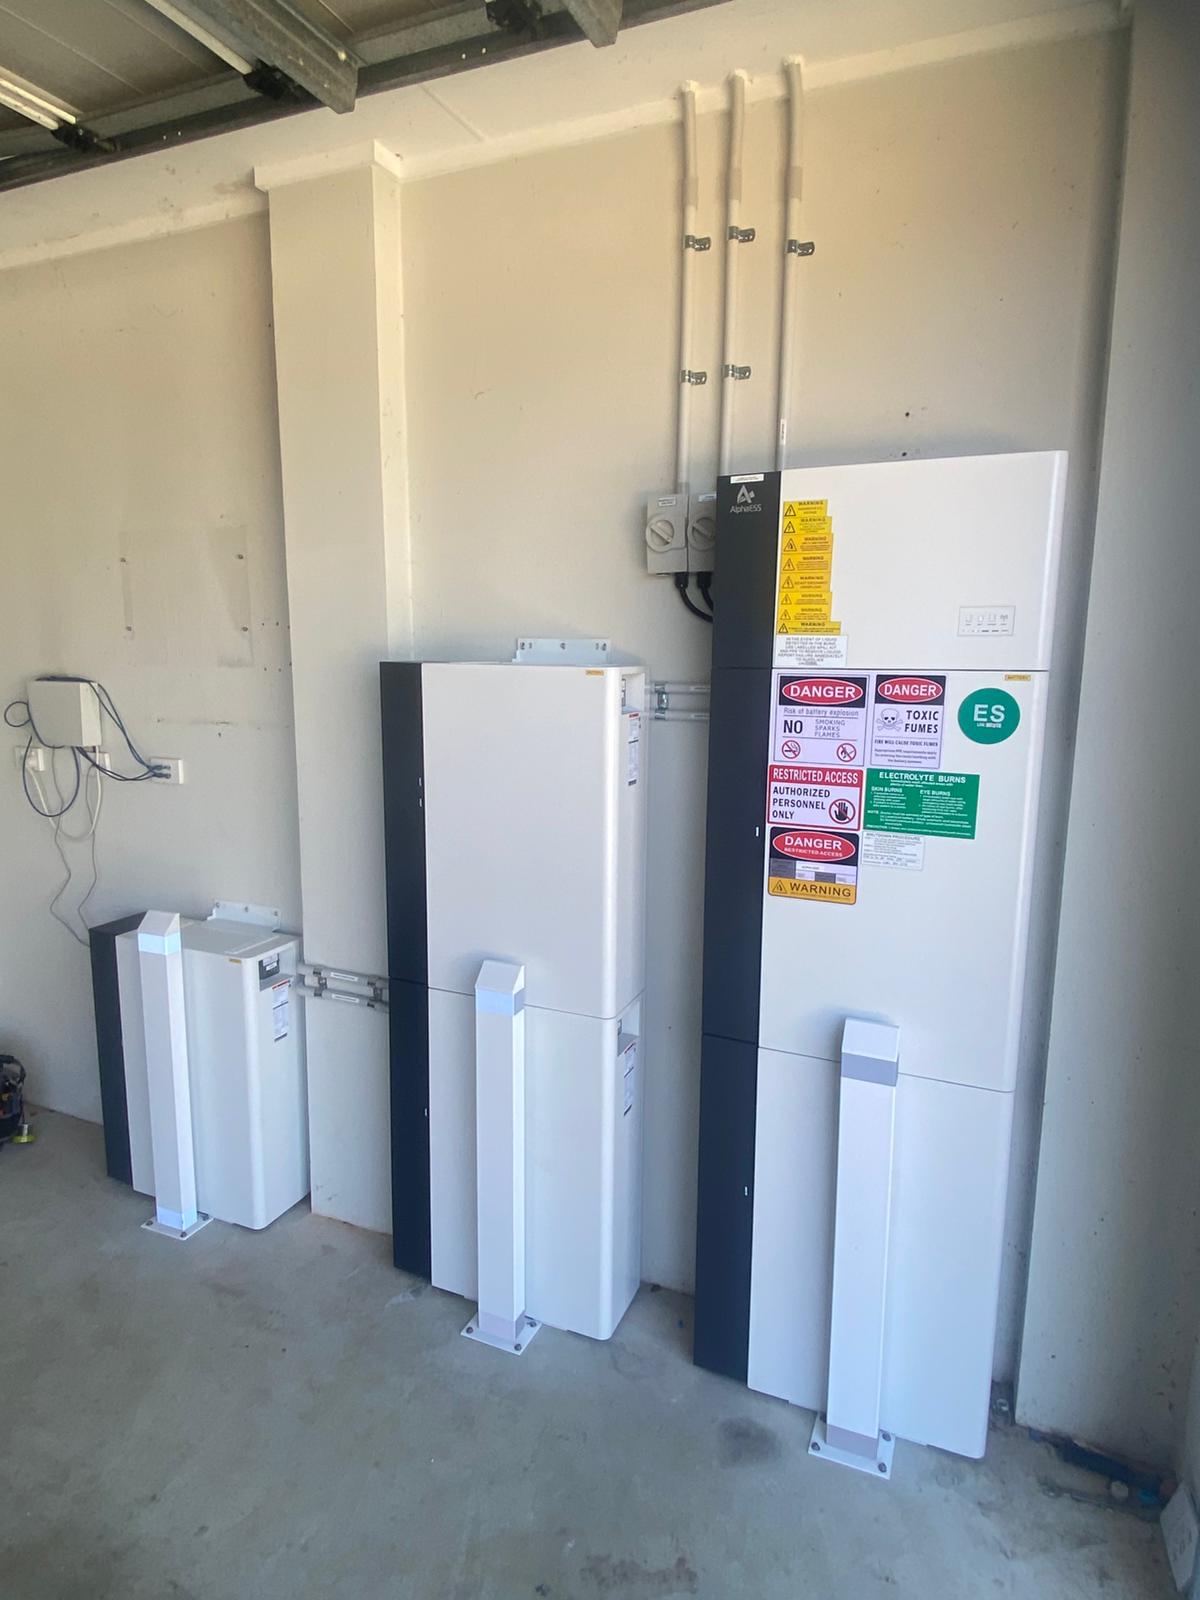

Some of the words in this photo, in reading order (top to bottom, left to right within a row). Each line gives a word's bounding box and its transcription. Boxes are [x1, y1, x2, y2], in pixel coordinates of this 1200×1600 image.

[730, 504, 762, 514] AlphaESS
[790, 685, 856, 698] DANGER
[884, 684, 937, 696] DANGER
[806, 708, 828, 716] battery
[906, 710, 939, 720] TOXIC
[974, 704, 1005, 722] ES
[783, 720, 804, 734] NO
[904, 724, 938, 734] FUMES
[773, 768, 822, 782] RESTRICTED
[824, 770, 858, 784] ACCESS
[879, 772, 934, 781] ELECTROLYTE
[938, 775, 966, 784] BURNS
[772, 786, 830, 798] AUTHORIZED
[772, 798, 826, 810] PERSONNEL
[772, 810, 794, 819] ONLY
[784, 836, 842, 850] DANGER
[790, 882, 850, 897] WARNING
